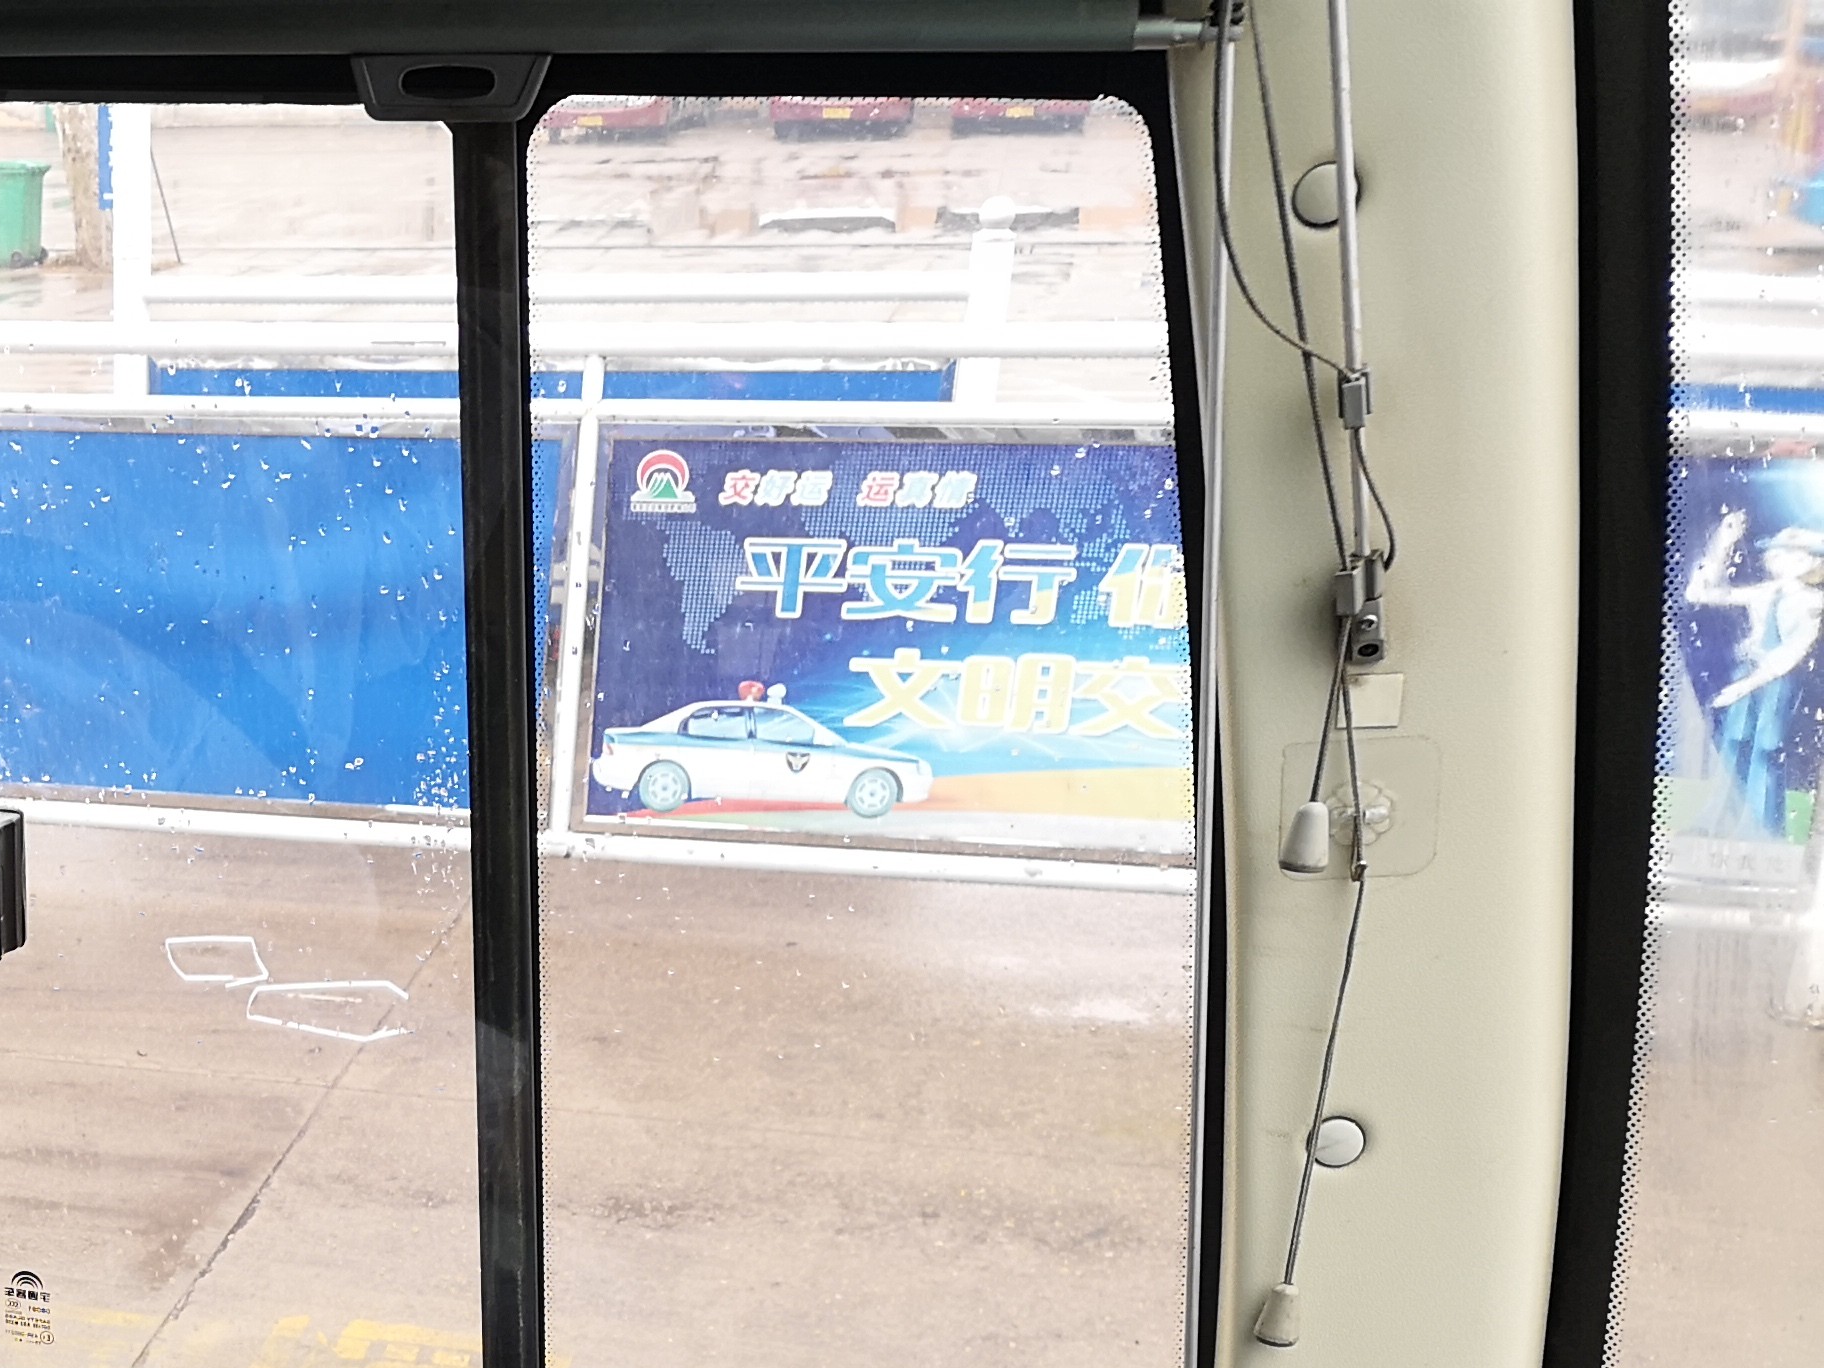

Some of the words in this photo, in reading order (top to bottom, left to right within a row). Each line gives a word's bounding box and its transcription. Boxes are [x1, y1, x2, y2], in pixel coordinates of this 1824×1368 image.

[719, 470, 833, 506] 交好运
[856, 470, 978, 508] 运真情
[735, 537, 1078, 625] 平安行
[844, 647, 1188, 739] 文明交
